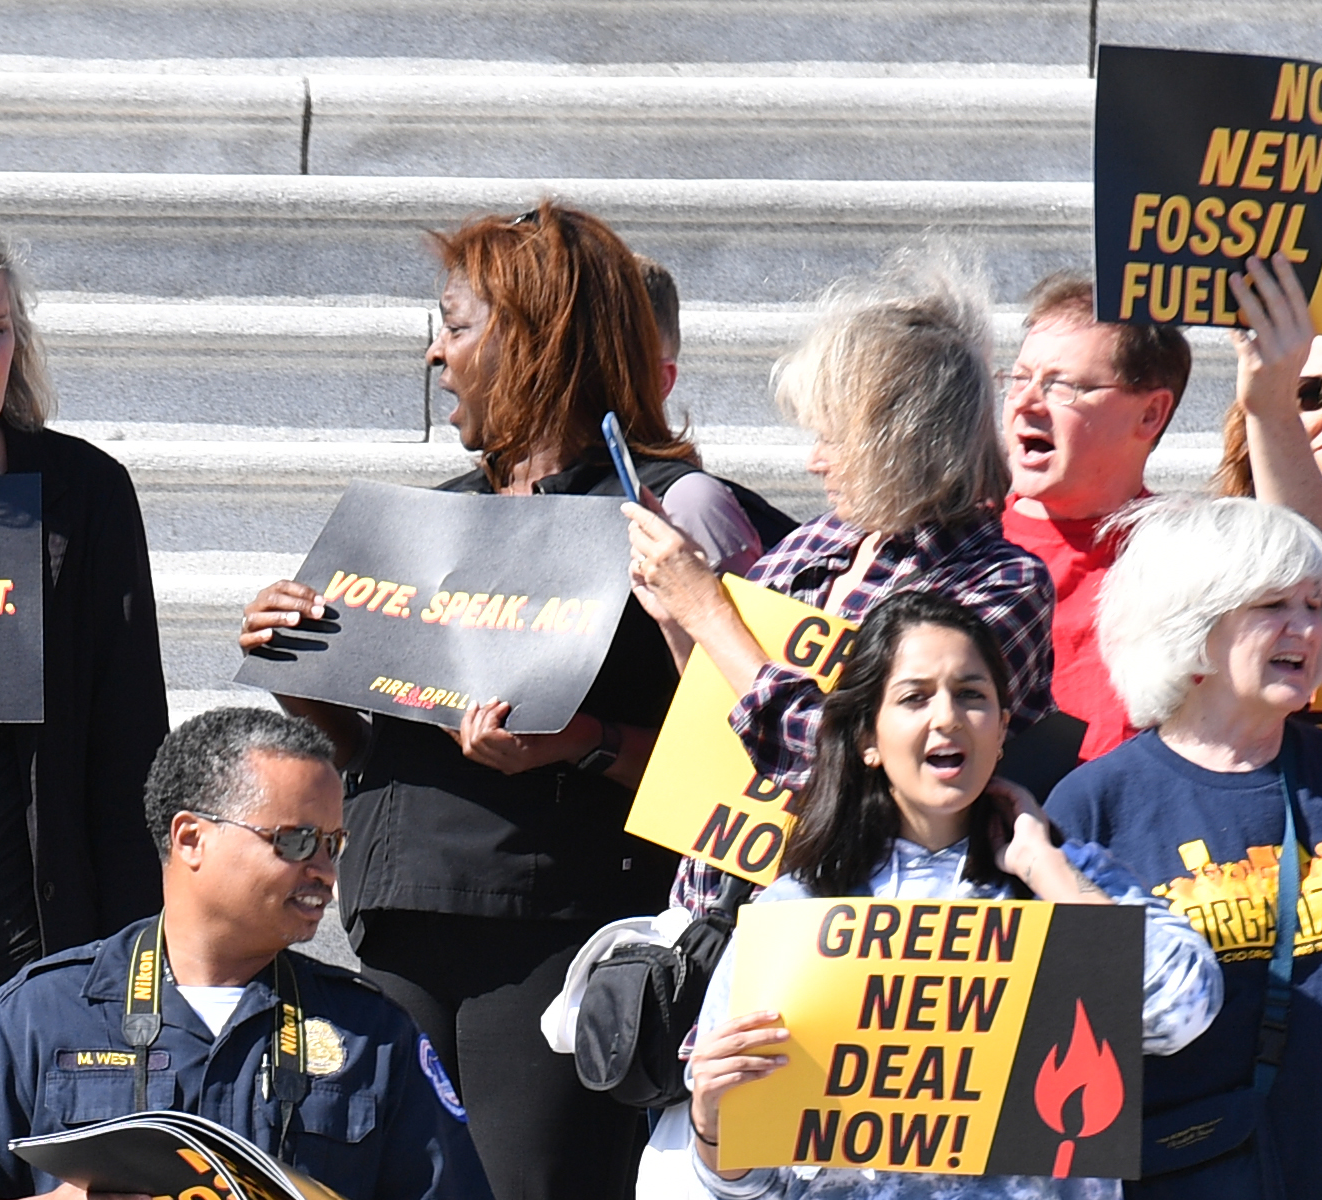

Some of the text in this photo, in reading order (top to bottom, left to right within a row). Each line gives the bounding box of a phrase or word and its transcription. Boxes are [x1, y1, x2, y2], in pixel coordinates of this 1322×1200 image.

[1129, 193, 1309, 263] FOSSIL
[324, 570, 604, 635] VOTE. SPEAK. ACT.
[369, 676, 470, 710] FIRE DRILL
[817, 903, 1023, 962] GREEN
[134, 950, 154, 1000] Nikon
[857, 974, 1010, 1033] NEW
[77, 1052, 136, 1066] M. WEST
[280, 1003, 297, 1056] Nikon
[823, 1043, 983, 1102] DEAL
[792, 1108, 971, 1169] NOW!
